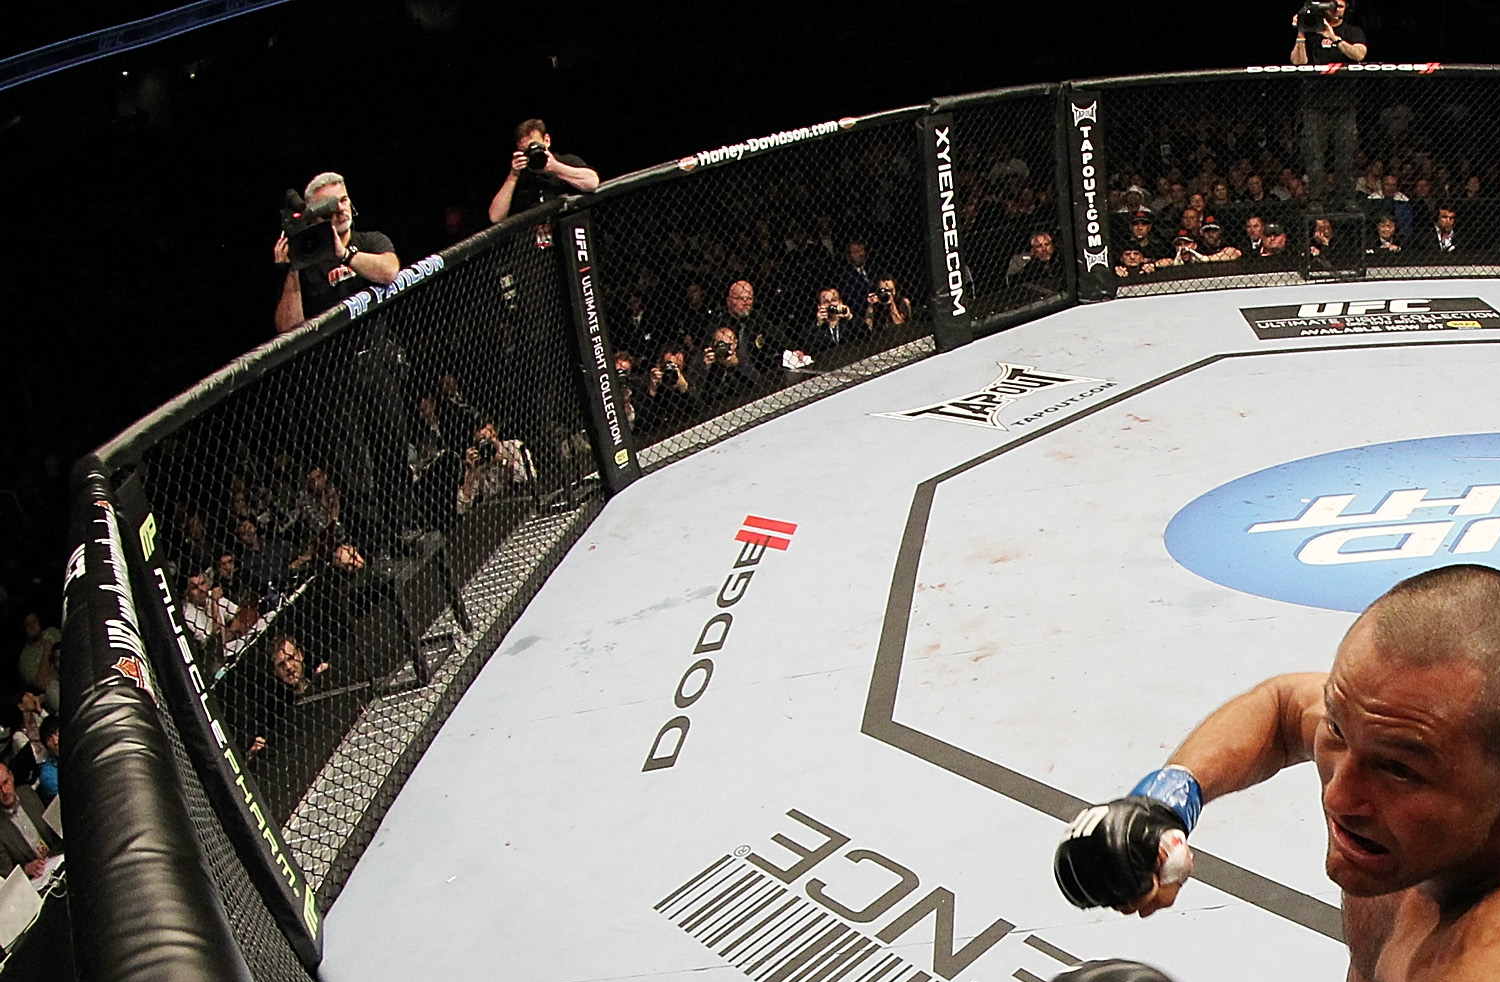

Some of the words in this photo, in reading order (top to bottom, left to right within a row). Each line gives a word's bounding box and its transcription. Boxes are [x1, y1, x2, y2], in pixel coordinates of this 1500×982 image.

[698, 120, 838, 167] Harley-Davidson.com
[1079, 125, 1101, 248] TAPOUT.COM
[574, 227, 589, 261] UFC
[935, 126, 966, 316] XYIENCE.COM
[343, 290, 372, 319] HP
[369, 254, 445, 304] PAVILION
[581, 275, 599, 334] ULTIMATE
[1297, 299, 1432, 319] UFC
[1256, 317, 1341, 330] ULTIMATE
[1399, 311, 1499, 322] COLLECTION
[1300, 325, 1382, 336] AVAILABLE
[1385, 323, 1420, 332] NOW
[591, 335, 607, 369] FIGHT
[599, 372, 622, 446] COLLECTION
[890, 365, 1085, 425] TAPOUT
[1011, 380, 1117, 427] TAPOUT.COM
[641, 536, 772, 772] DODGE
